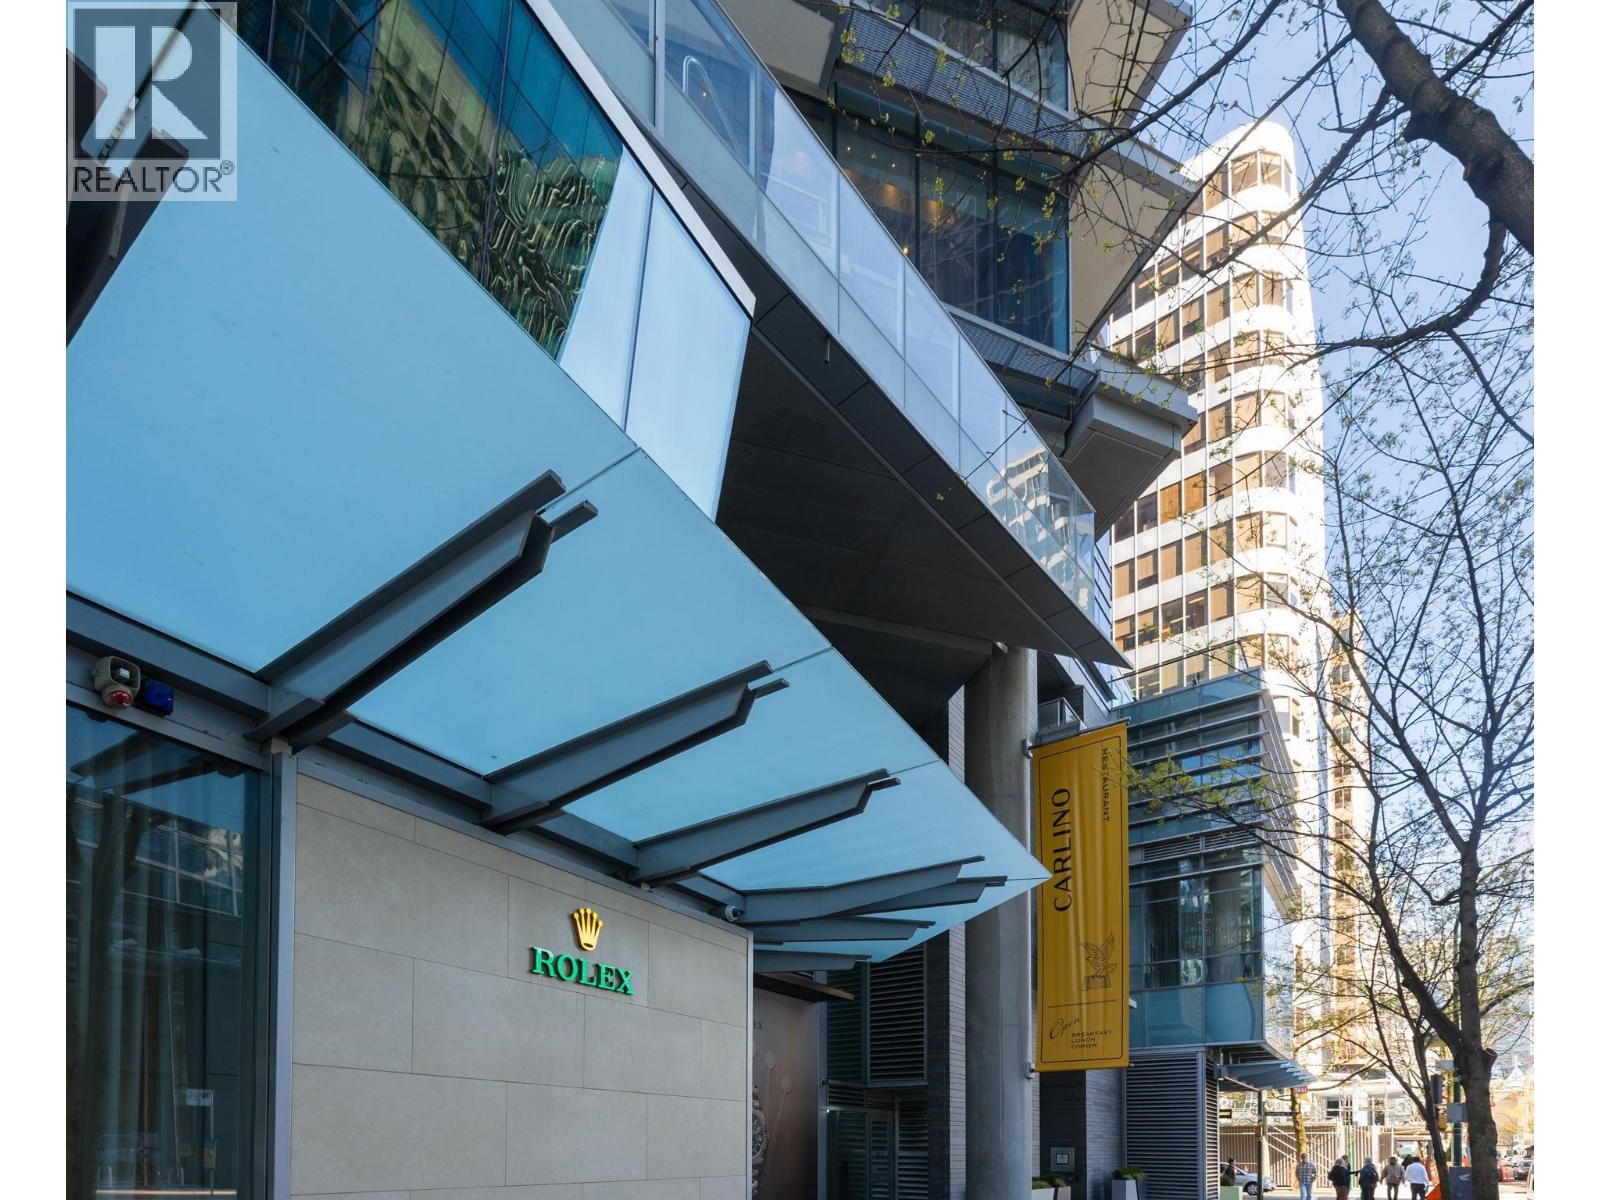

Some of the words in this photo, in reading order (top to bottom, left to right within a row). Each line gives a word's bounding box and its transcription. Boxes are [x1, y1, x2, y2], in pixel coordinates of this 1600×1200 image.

[1052, 788, 1073, 912] CARLINO
[530, 946, 636, 996] ROLEX
[1071, 1029, 1112, 1038] BREAKFAST
